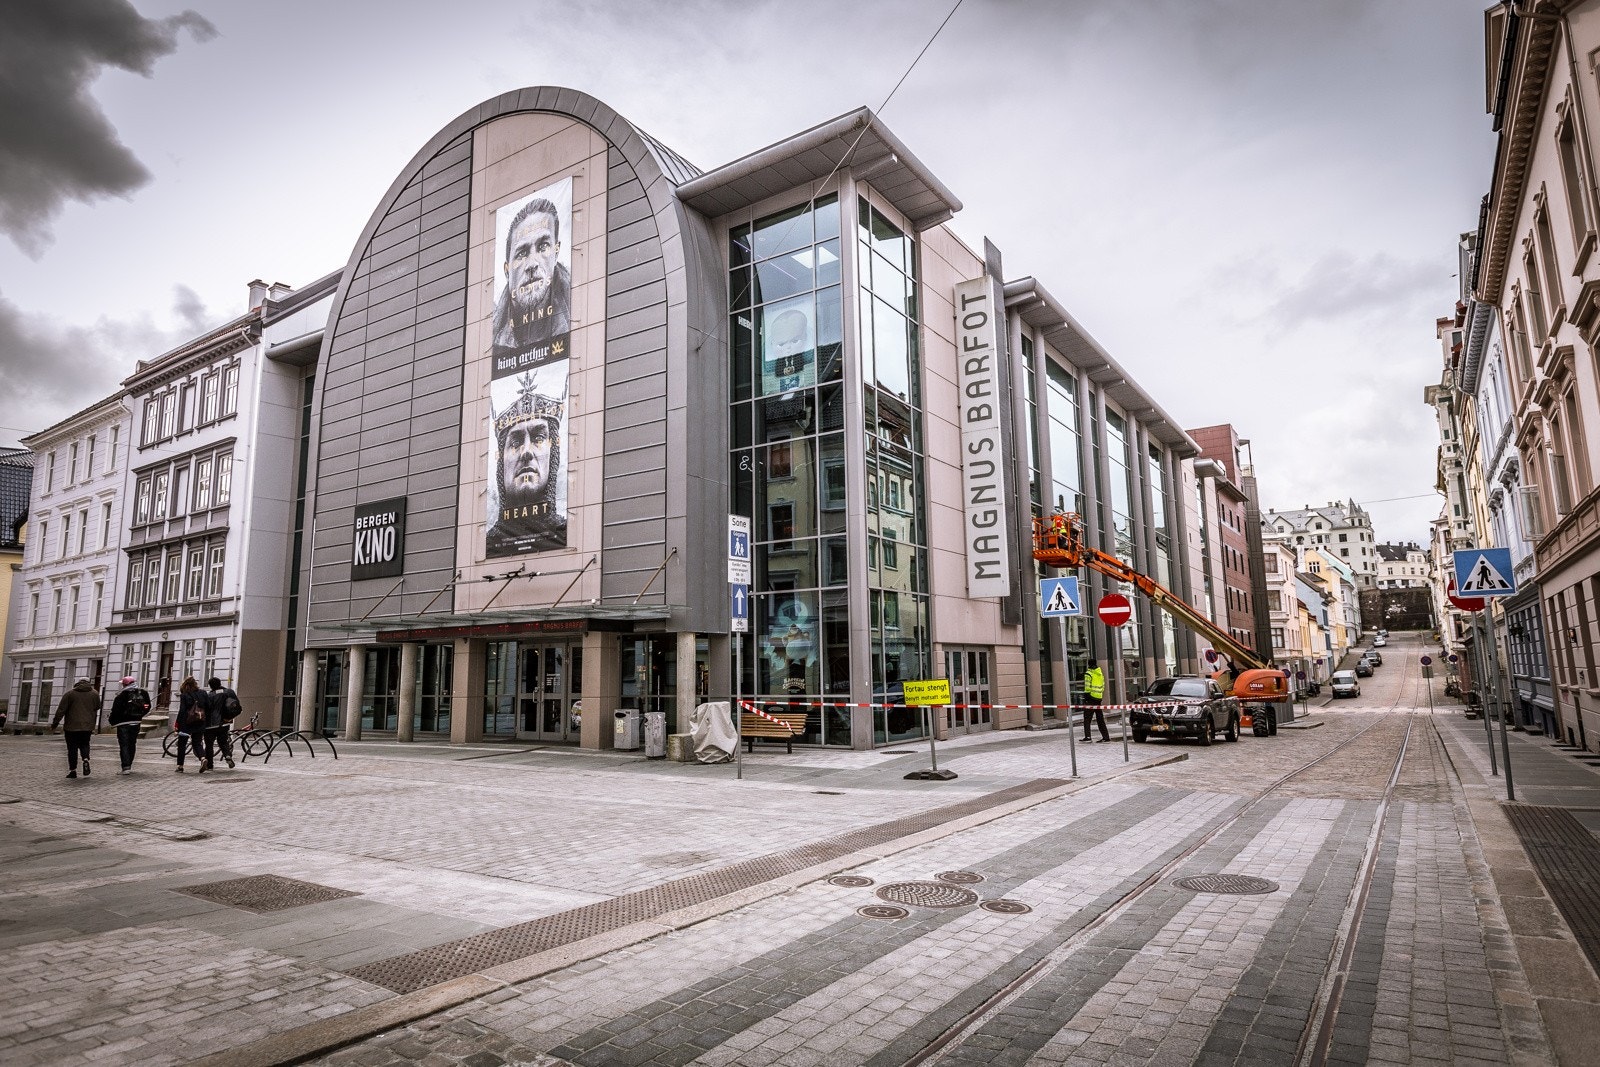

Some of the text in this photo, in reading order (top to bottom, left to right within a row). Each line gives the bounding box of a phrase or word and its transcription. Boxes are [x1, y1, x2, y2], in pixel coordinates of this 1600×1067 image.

[511, 276, 551, 298] COMES
[509, 305, 553, 328] A KING
[497, 357, 517, 370] king
[519, 346, 549, 364] arthur
[961, 293, 1001, 580] MAGNUS BARFOT
[356, 511, 396, 529] BERGEN
[503, 502, 548, 520] HEART
[731, 517, 747, 528] Sone
[927, 684, 947, 692] stengt
